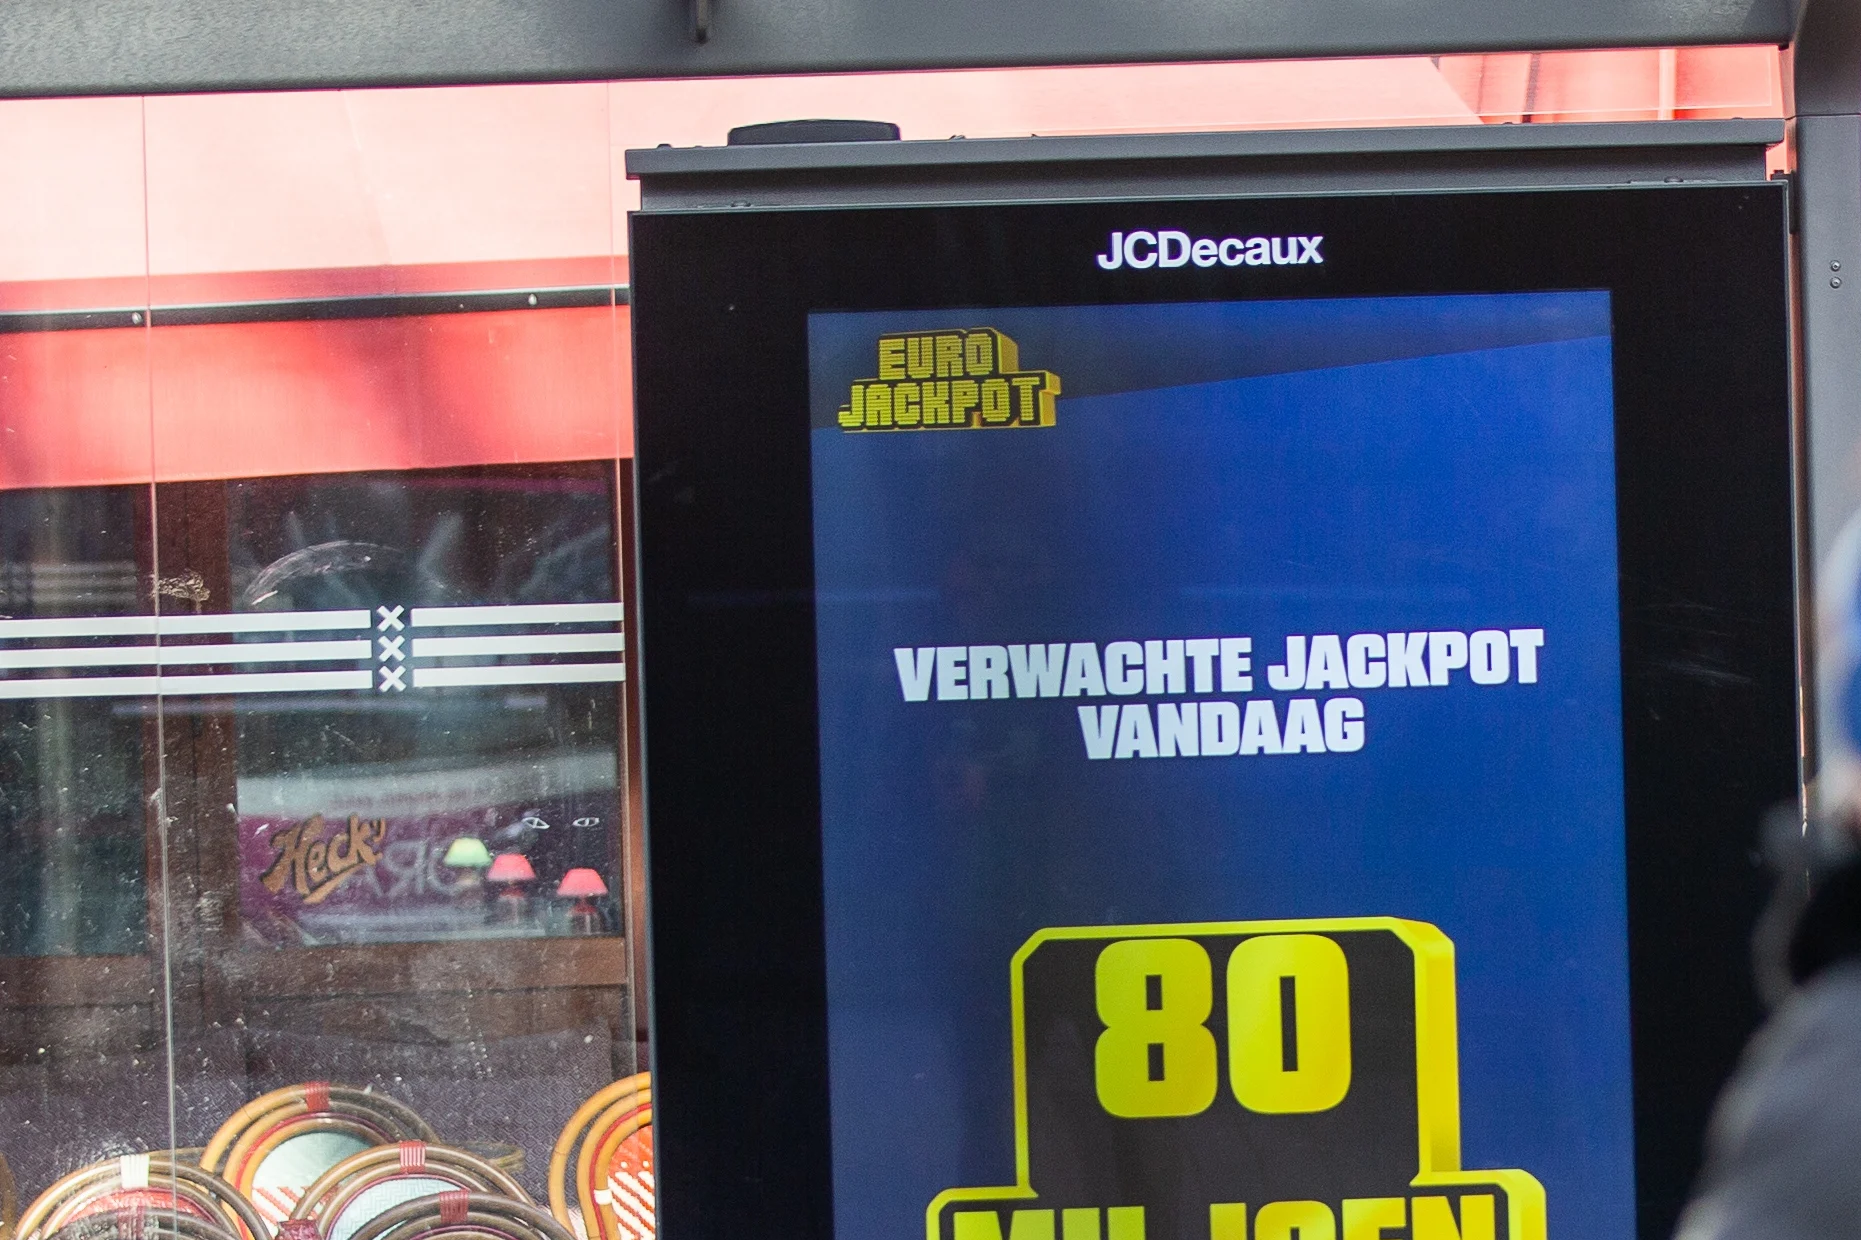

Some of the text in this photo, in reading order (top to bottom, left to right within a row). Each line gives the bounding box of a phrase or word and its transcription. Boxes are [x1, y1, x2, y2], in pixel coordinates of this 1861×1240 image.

[1097, 230, 1324, 270] JCDecaux
[878, 333, 994, 380] EURO
[838, 376, 1041, 427] JACKPOT
[894, 628, 1545, 701] VERWACHTE JACKPOT
[1077, 698, 1366, 760] VANDAAG
[1094, 933, 1352, 1118] 80
